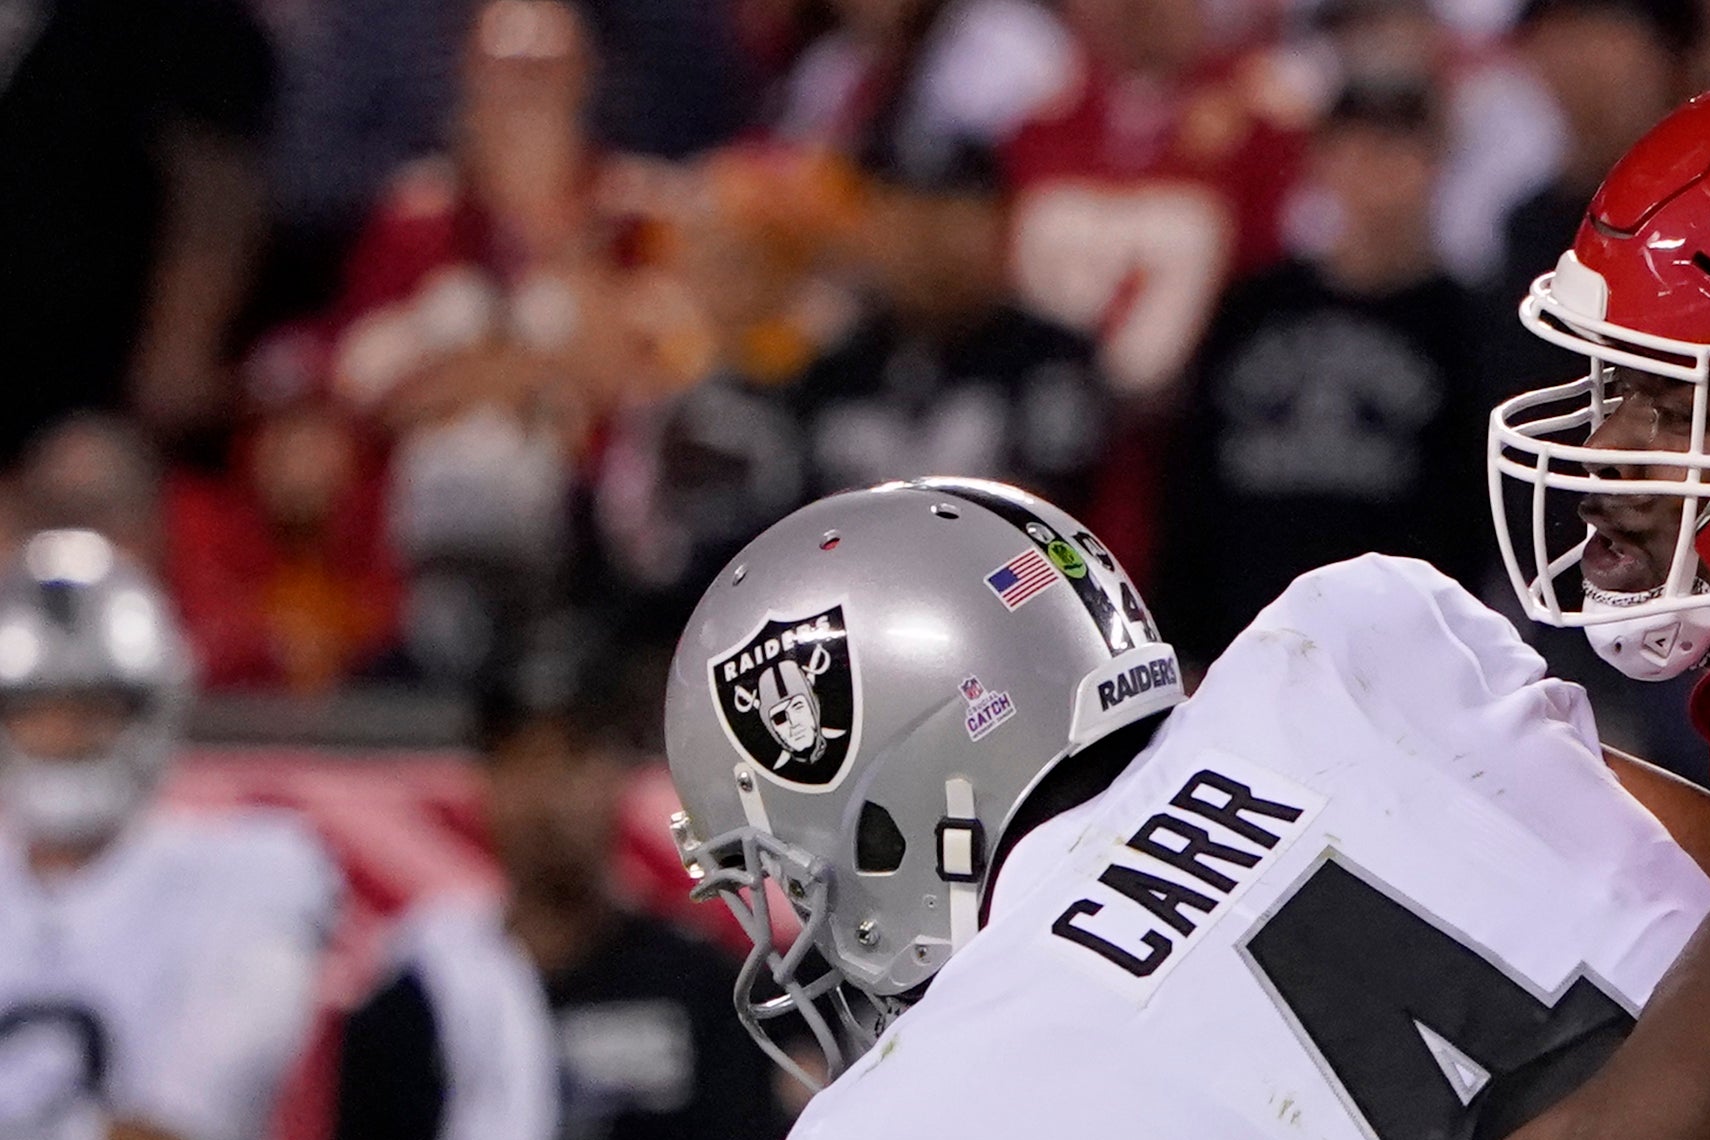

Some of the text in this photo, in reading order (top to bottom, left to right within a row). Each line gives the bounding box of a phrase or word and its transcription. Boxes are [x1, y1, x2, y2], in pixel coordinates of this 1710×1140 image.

[723, 614, 831, 683] RAIDERS
[967, 692, 1011, 732] CATCH
[1097, 656, 1177, 712] RAIDERS
[1051, 768, 1305, 978] CARR
